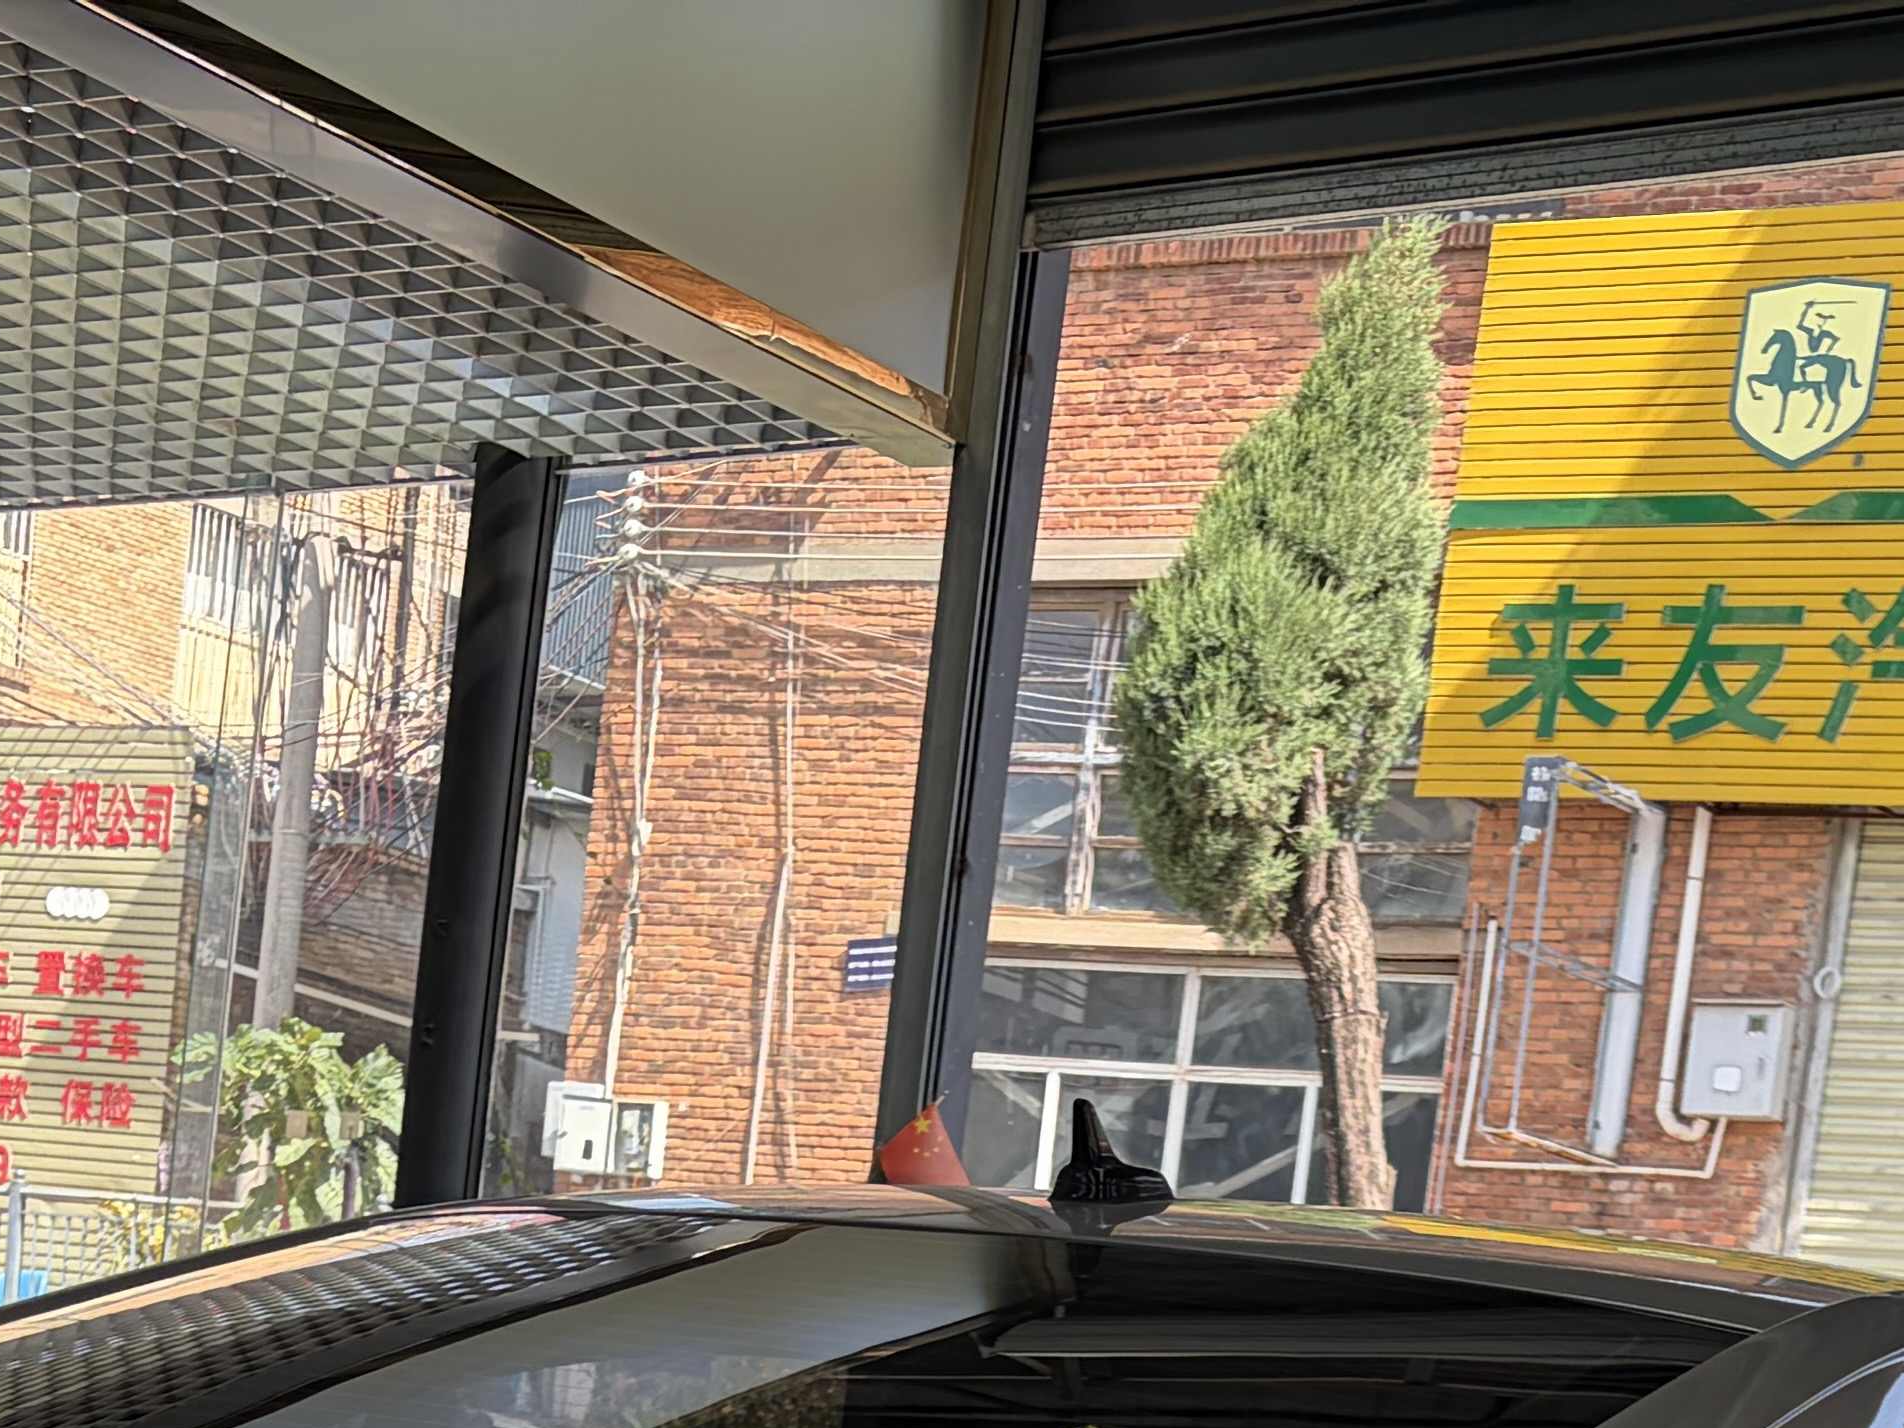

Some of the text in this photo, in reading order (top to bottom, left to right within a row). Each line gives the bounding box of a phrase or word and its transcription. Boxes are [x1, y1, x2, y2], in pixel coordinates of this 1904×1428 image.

[32, 950, 144, 999] 置换车
[61, 1079, 136, 1129] 保险
